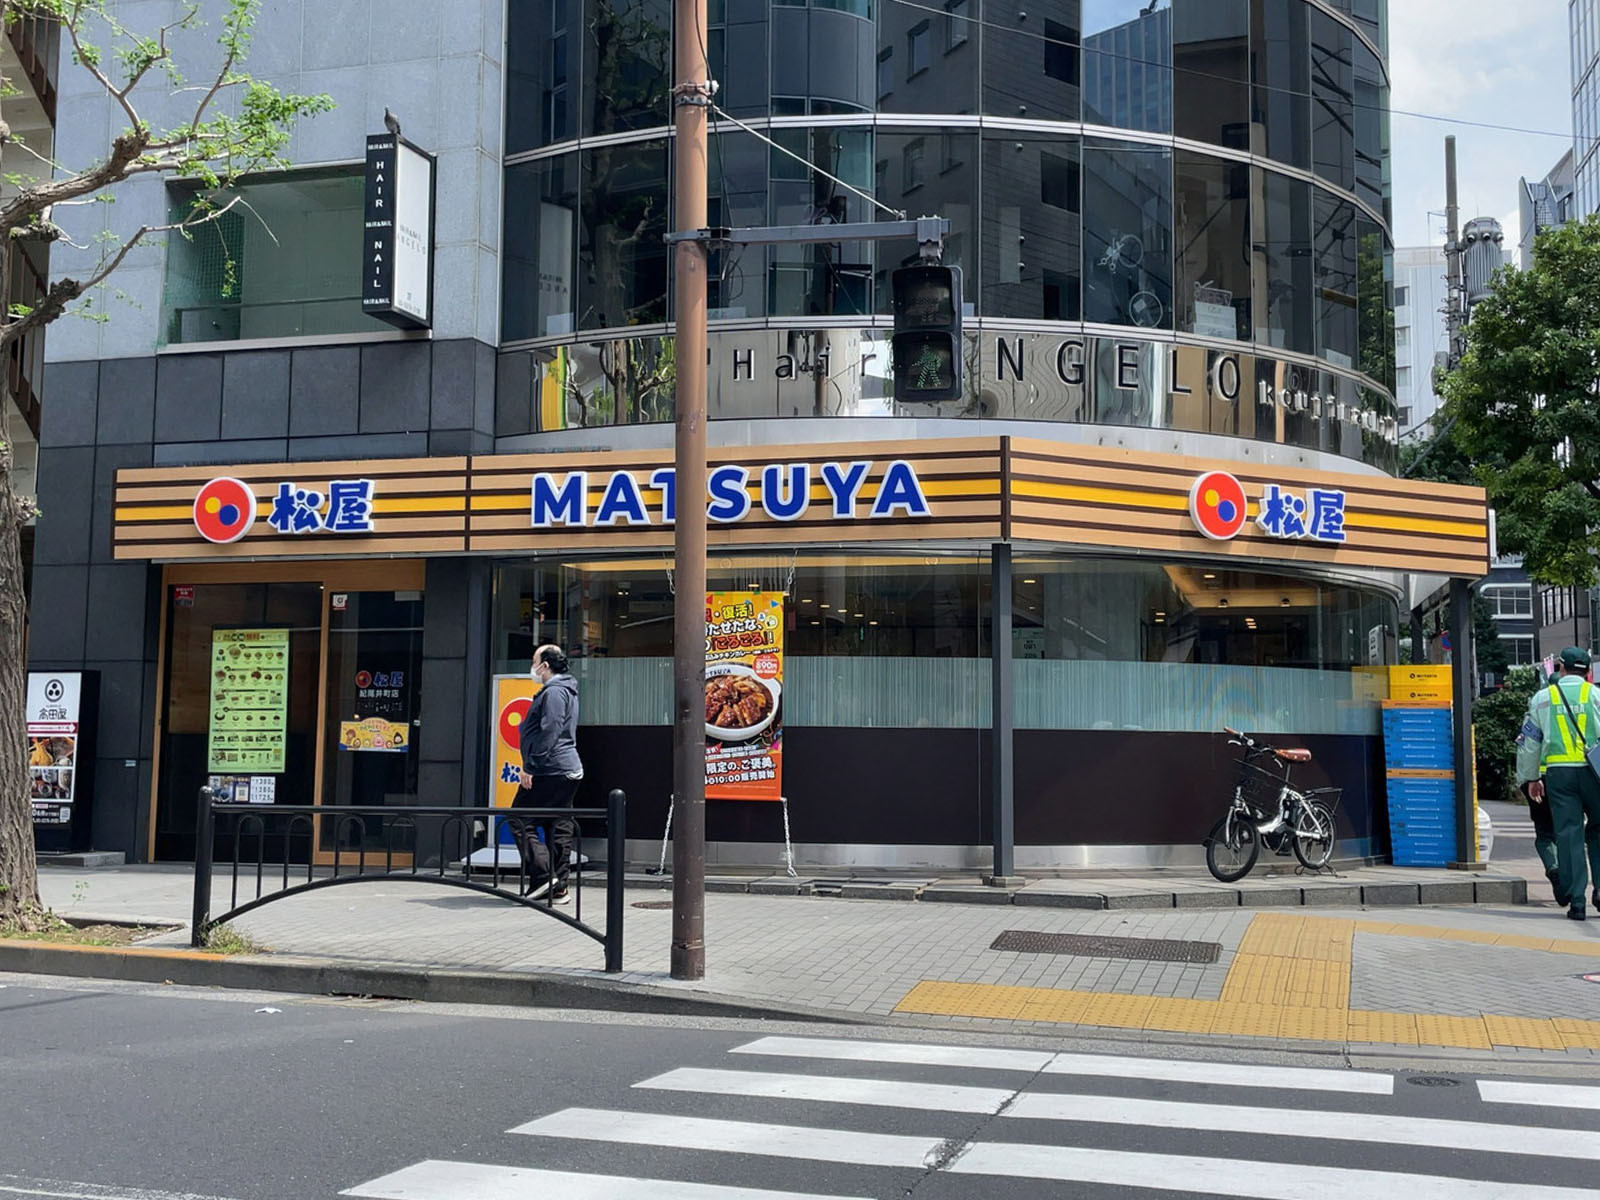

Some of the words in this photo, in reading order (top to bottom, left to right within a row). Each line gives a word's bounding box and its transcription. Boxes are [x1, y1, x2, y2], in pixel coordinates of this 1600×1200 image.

[375, 161, 385, 208] HAIR
[373, 240, 383, 288] NAIL
[732, 345, 876, 382] Hair
[963, 336, 1240, 401] NGELO
[267, 478, 375, 534] 松屋
[531, 460, 932, 527] MATSUYA
[1256, 484, 1347, 543] 松屋
[705, 618, 763, 638] たせたな、
[500, 761, 522, 784] 松
